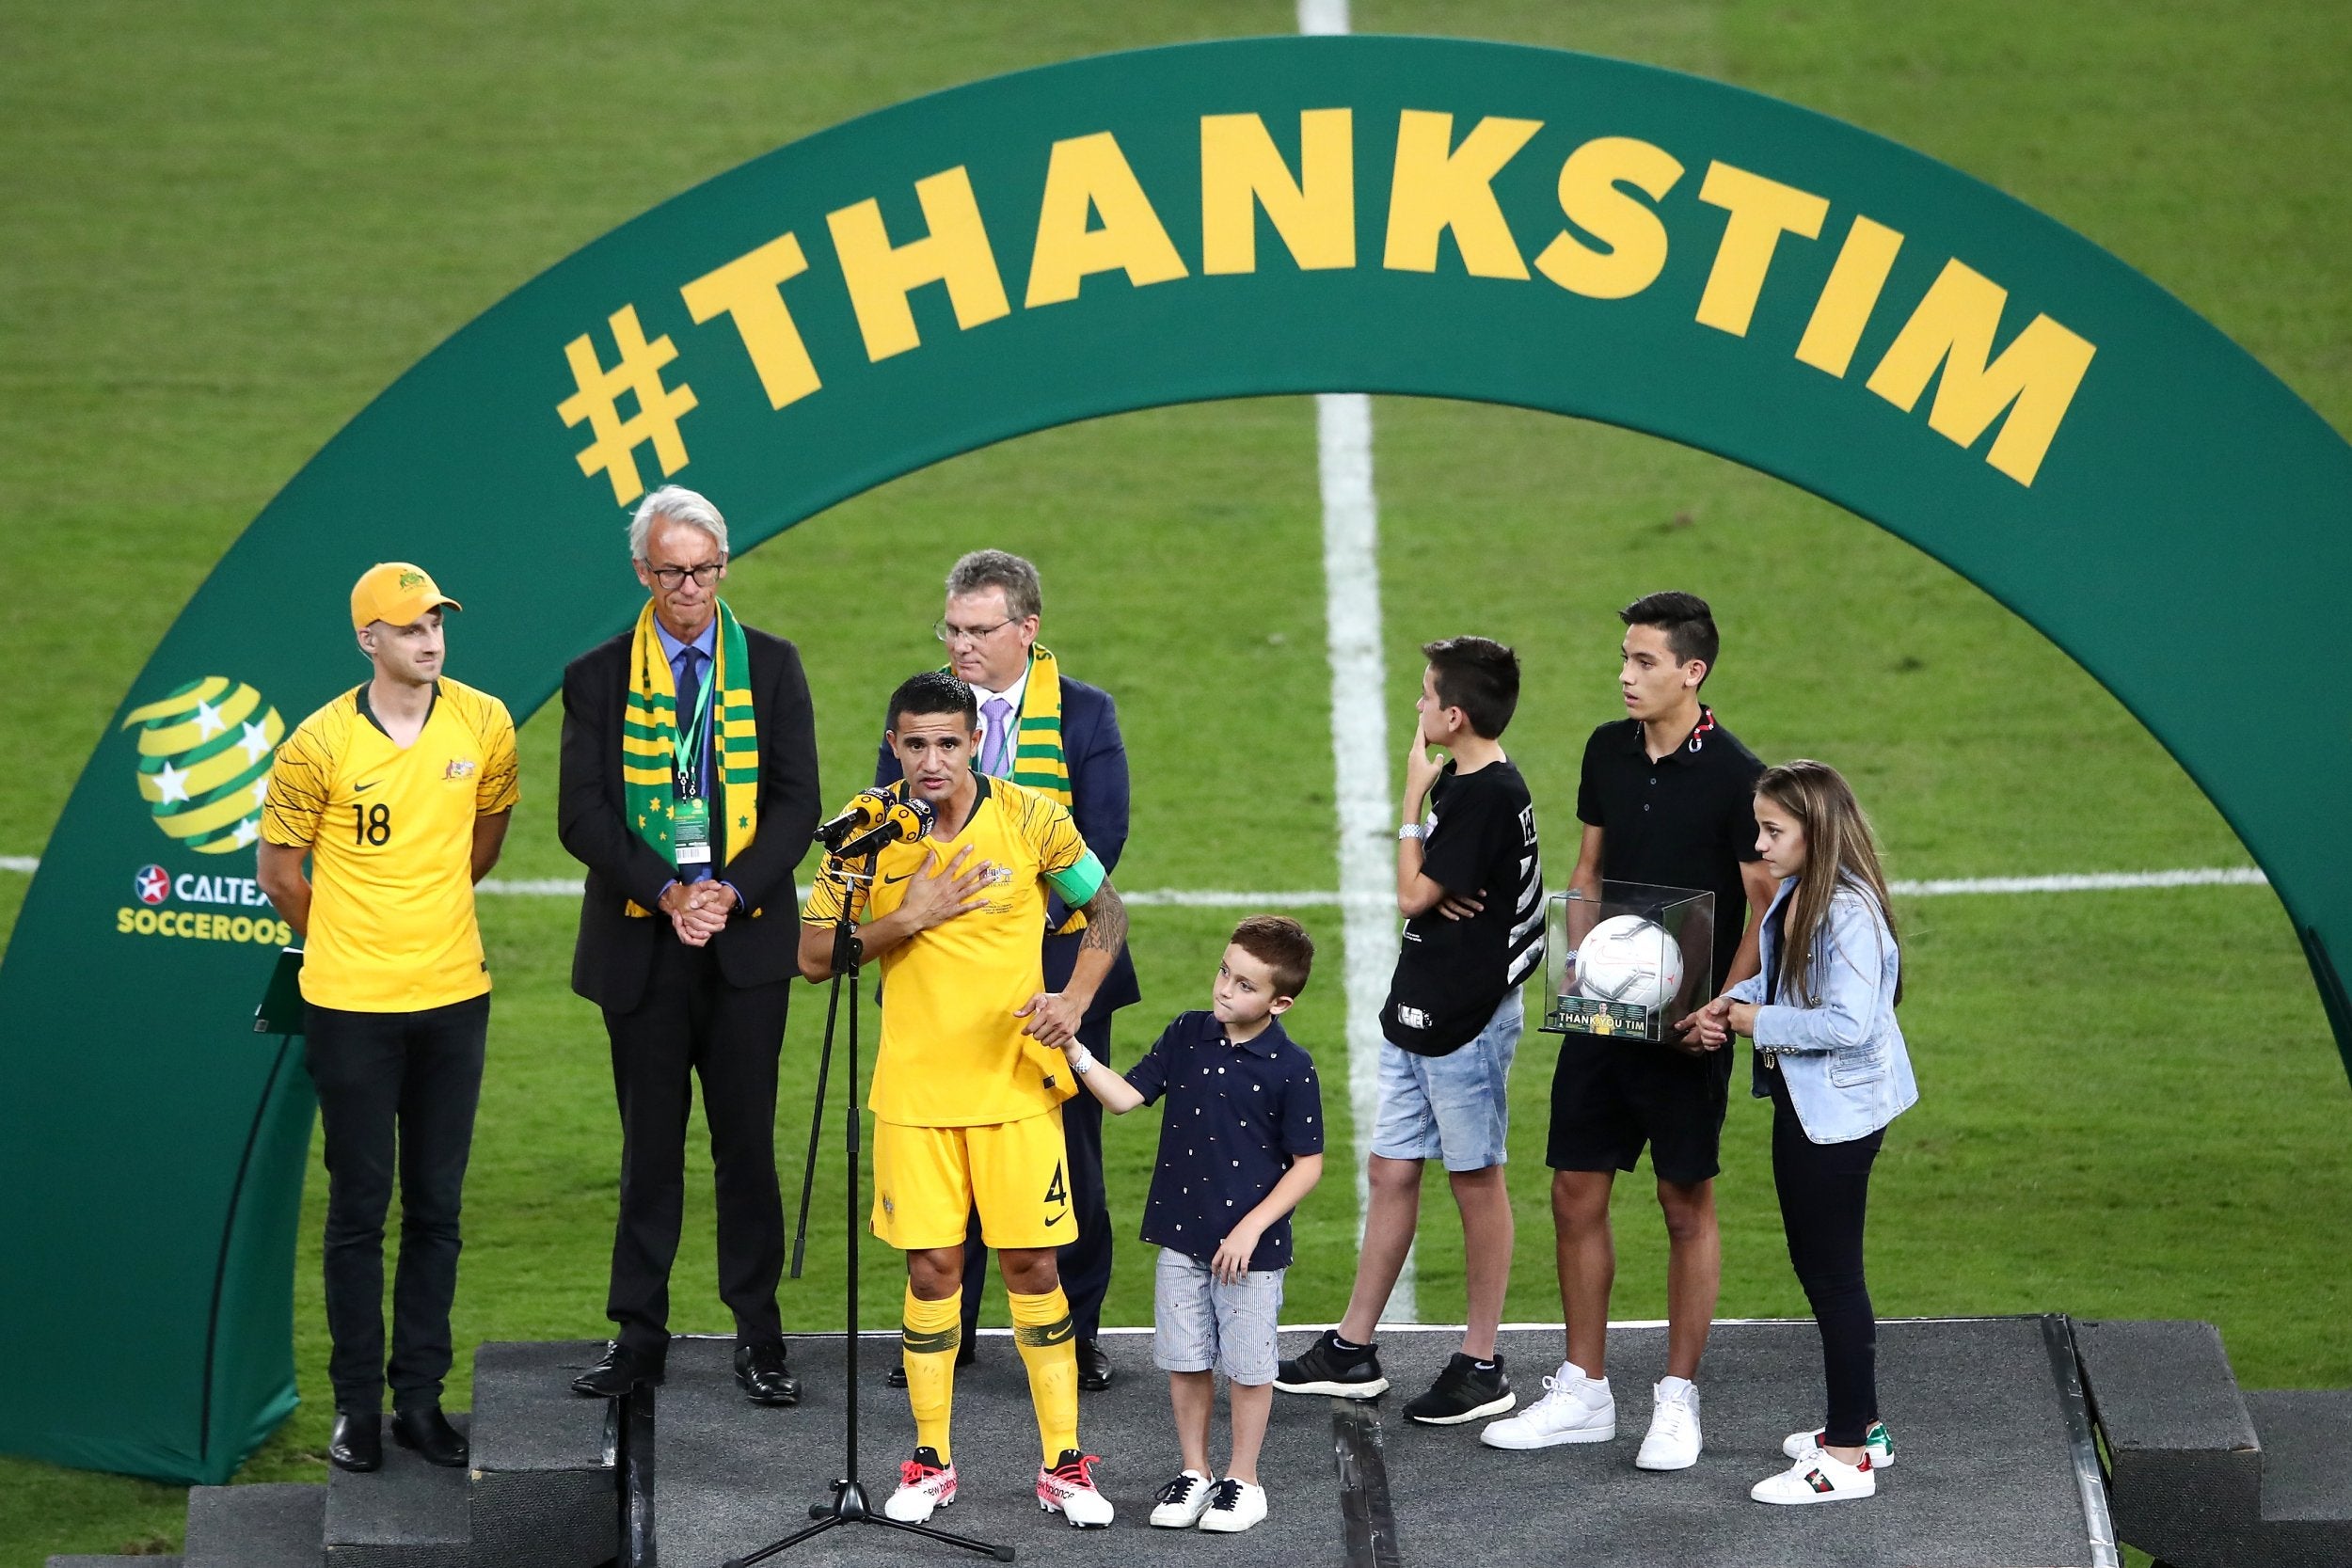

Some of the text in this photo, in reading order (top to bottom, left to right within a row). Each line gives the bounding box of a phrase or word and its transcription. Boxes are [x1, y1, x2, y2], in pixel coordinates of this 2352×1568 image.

[556, 106, 2097, 509] #THANKSTIM
[353, 803, 391, 847] 18
[117, 907, 293, 946] SOCCEROOS
[1559, 1012, 1597, 1026] THANK
[1598, 1017, 1623, 1028] YOU
[1626, 1020, 1645, 1031] TIM
[1043, 1158, 1067, 1207] 4
